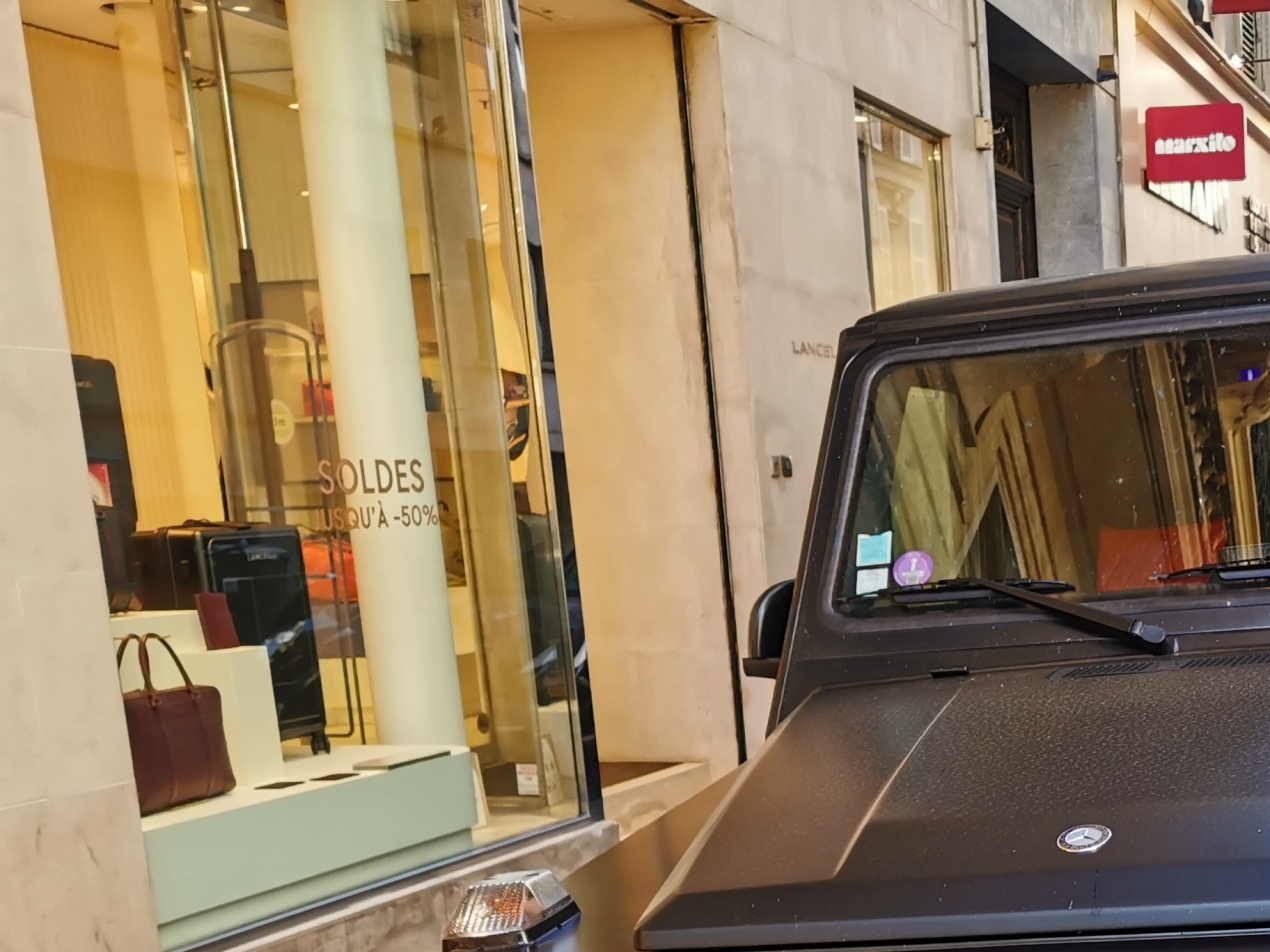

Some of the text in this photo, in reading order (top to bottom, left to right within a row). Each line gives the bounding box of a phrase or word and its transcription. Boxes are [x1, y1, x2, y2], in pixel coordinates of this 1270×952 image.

[1154, 131, 1237, 156] marxito
[791, 339, 837, 359] LANCEL
[318, 458, 425, 495] SOLDES
[393, 504, 439, 527] -50%
